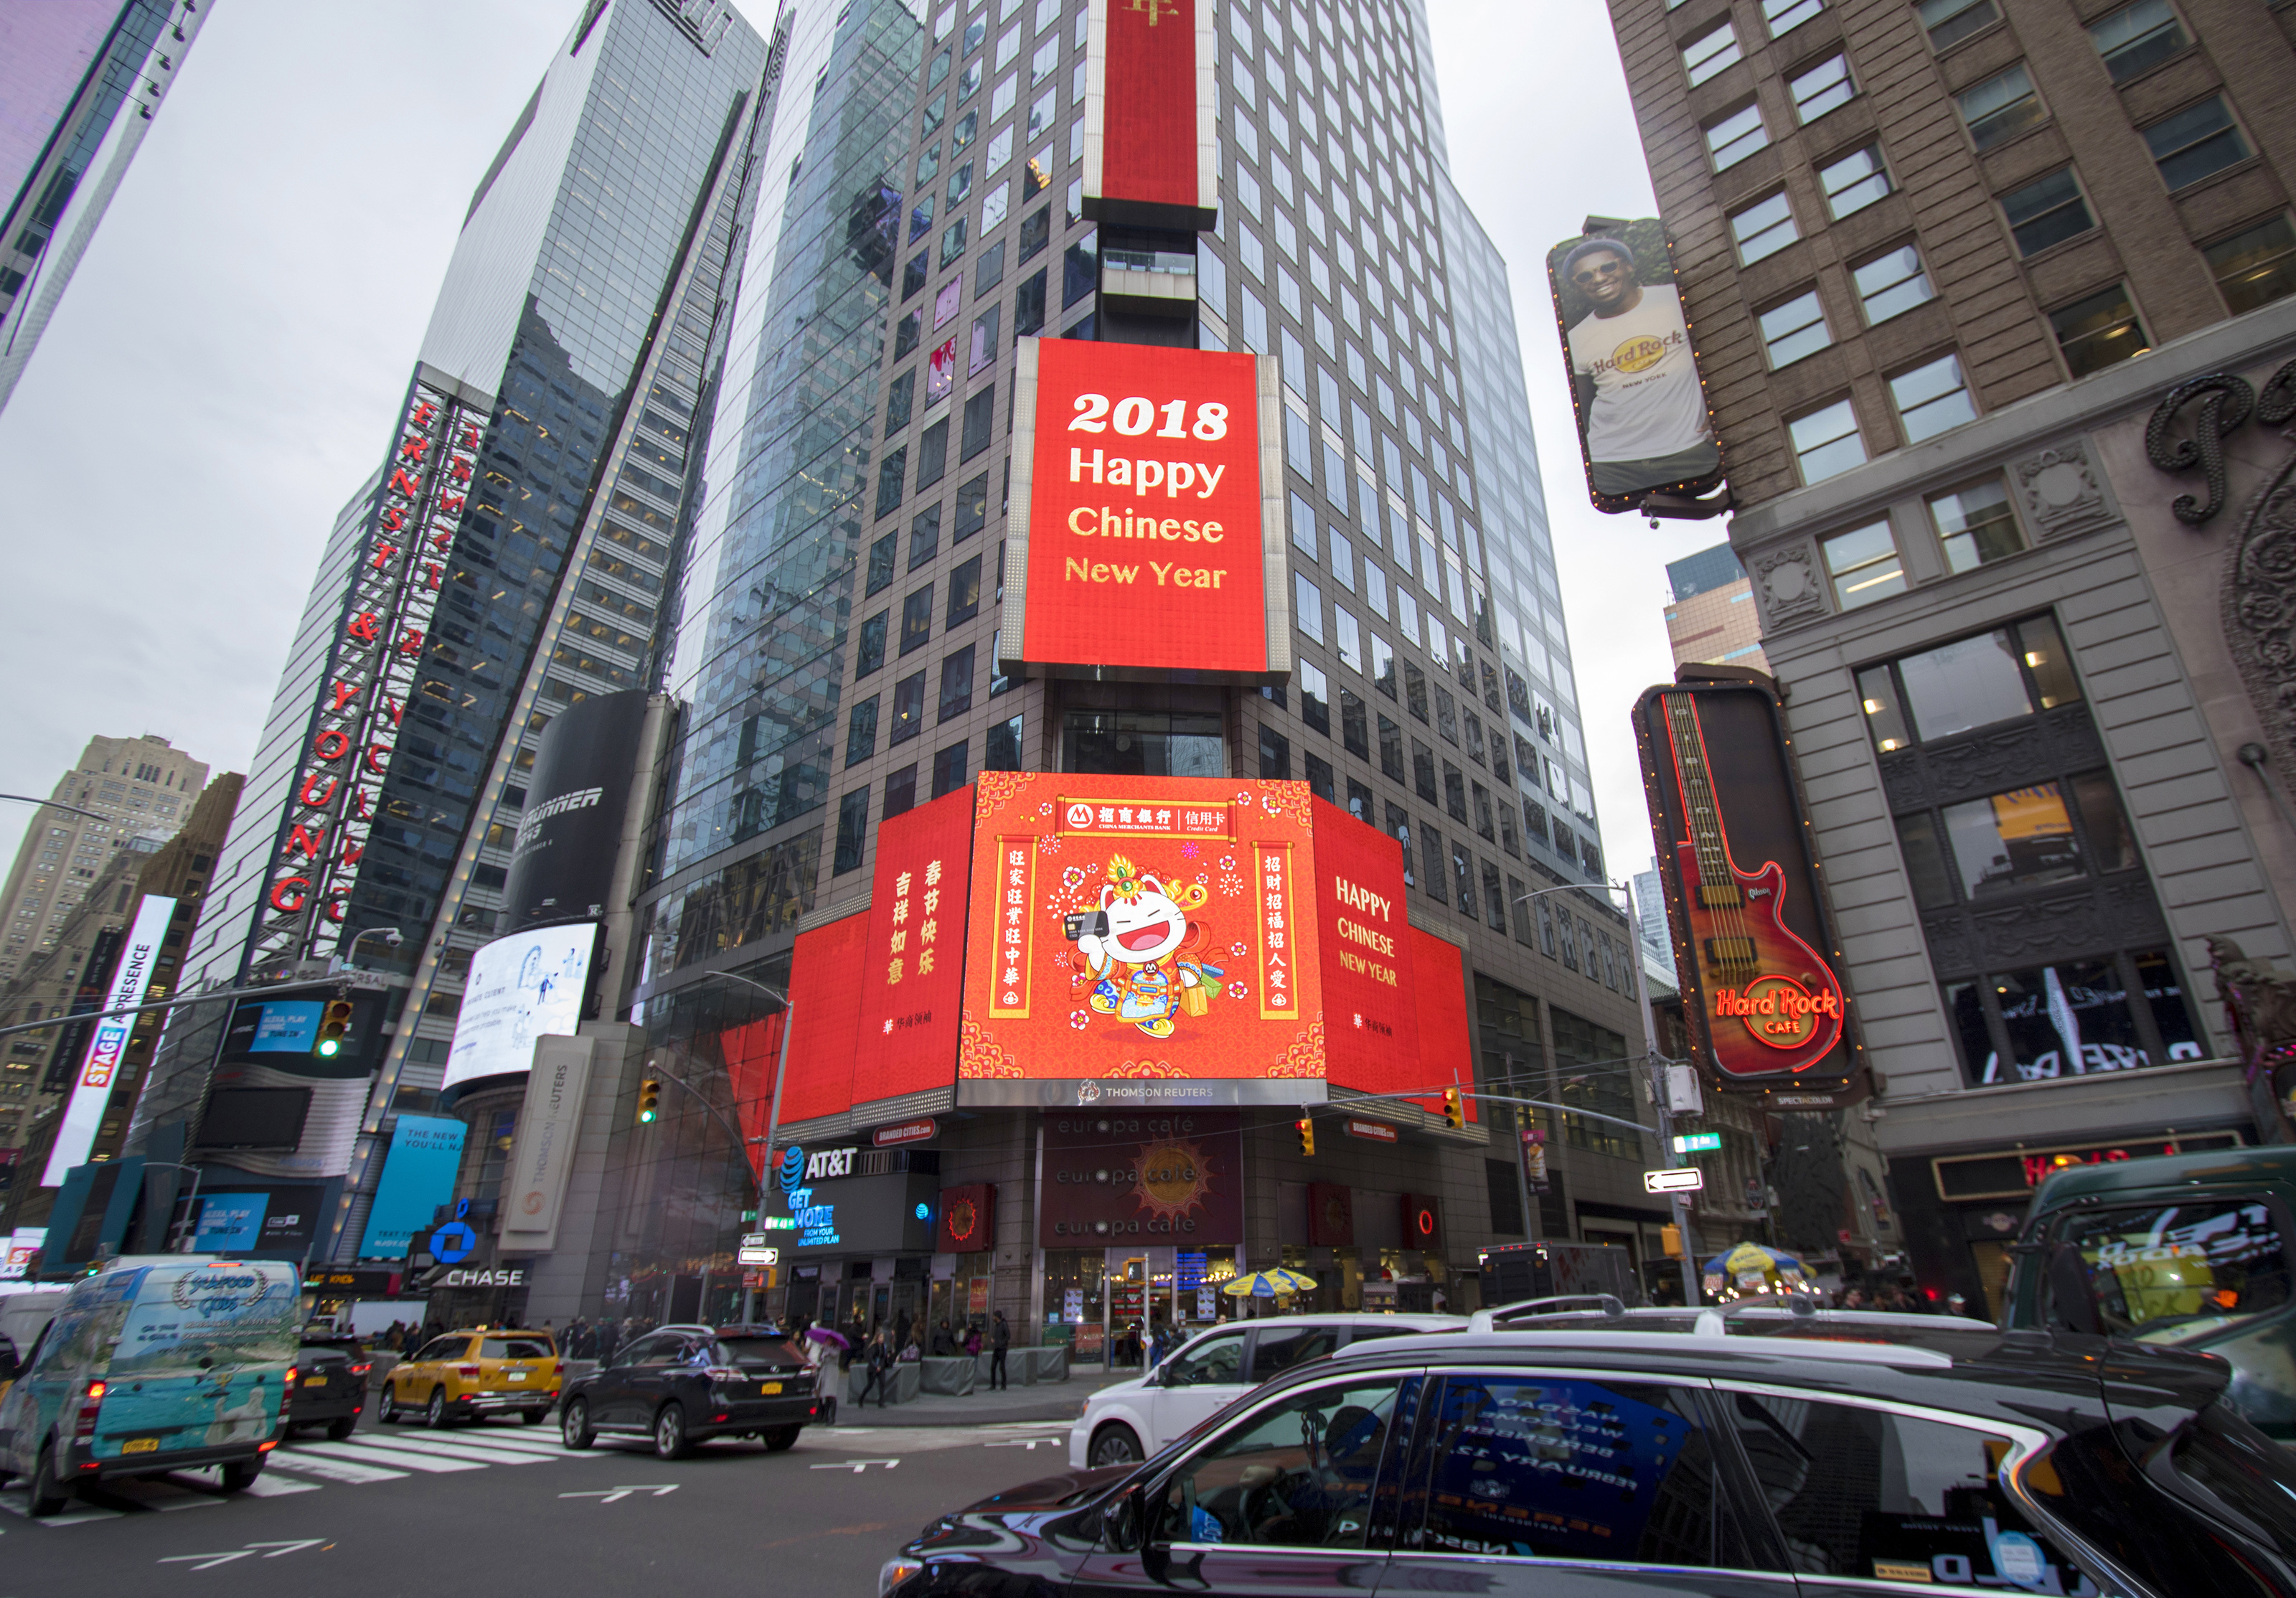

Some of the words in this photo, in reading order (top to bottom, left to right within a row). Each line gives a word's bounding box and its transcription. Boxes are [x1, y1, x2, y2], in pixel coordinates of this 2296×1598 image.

[1594, 345, 1635, 375] Hard
[1637, 329, 1683, 357] Rock
[1622, 379, 1642, 390] NEW
[1644, 370, 1667, 384] YORK
[1067, 393, 1229, 441] 2018
[1069, 447, 1225, 499] Happy
[1068, 505, 1224, 543] Chinese
[1065, 556, 1139, 584] New
[1149, 560, 1228, 589] Year
[1185, 811, 1225, 826] 信用卡
[1335, 875, 1391, 922] HAPPY
[887, 871, 911, 984] 吉祥如意
[918, 860, 941, 975] 春节快乐
[1337, 917, 1395, 958] CHINESE
[1340, 950, 1366, 975] NEW
[1368, 961, 1397, 987] YEAR
[1716, 987, 1775, 1017] Hard
[1779, 986, 1840, 1020] Rock
[1764, 1020, 1802, 1035] CAFE
[86, 1030, 123, 1085] STAGE
[1106, 1088, 1162, 1098] THOMSON
[1164, 1088, 1213, 1098] REUTERS
[1777, 1096, 1834, 1105] SPECTACOLOR
[408, 1129, 431, 1139] THE
[434, 1132, 458, 1141] NEW
[879, 1129, 903, 1141] BRANDED
[903, 1125, 931, 1137] CITIES.com
[1352, 1122, 1373, 1136] BRANDED
[405, 1139, 444, 1150] YOU'LL
[532, 1122, 555, 1184] THOMSON
[805, 1147, 858, 1179] AT&T
[788, 1188, 812, 1211] GET
[794, 1205, 834, 1228] MORE
[798, 1236, 823, 1247] UNLIMITED
[823, 1234, 839, 1245] PLAN
[804, 1228, 818, 1238] FROM
[819, 1226, 834, 1236] YOUR
[446, 1269, 524, 1286] CHASE
